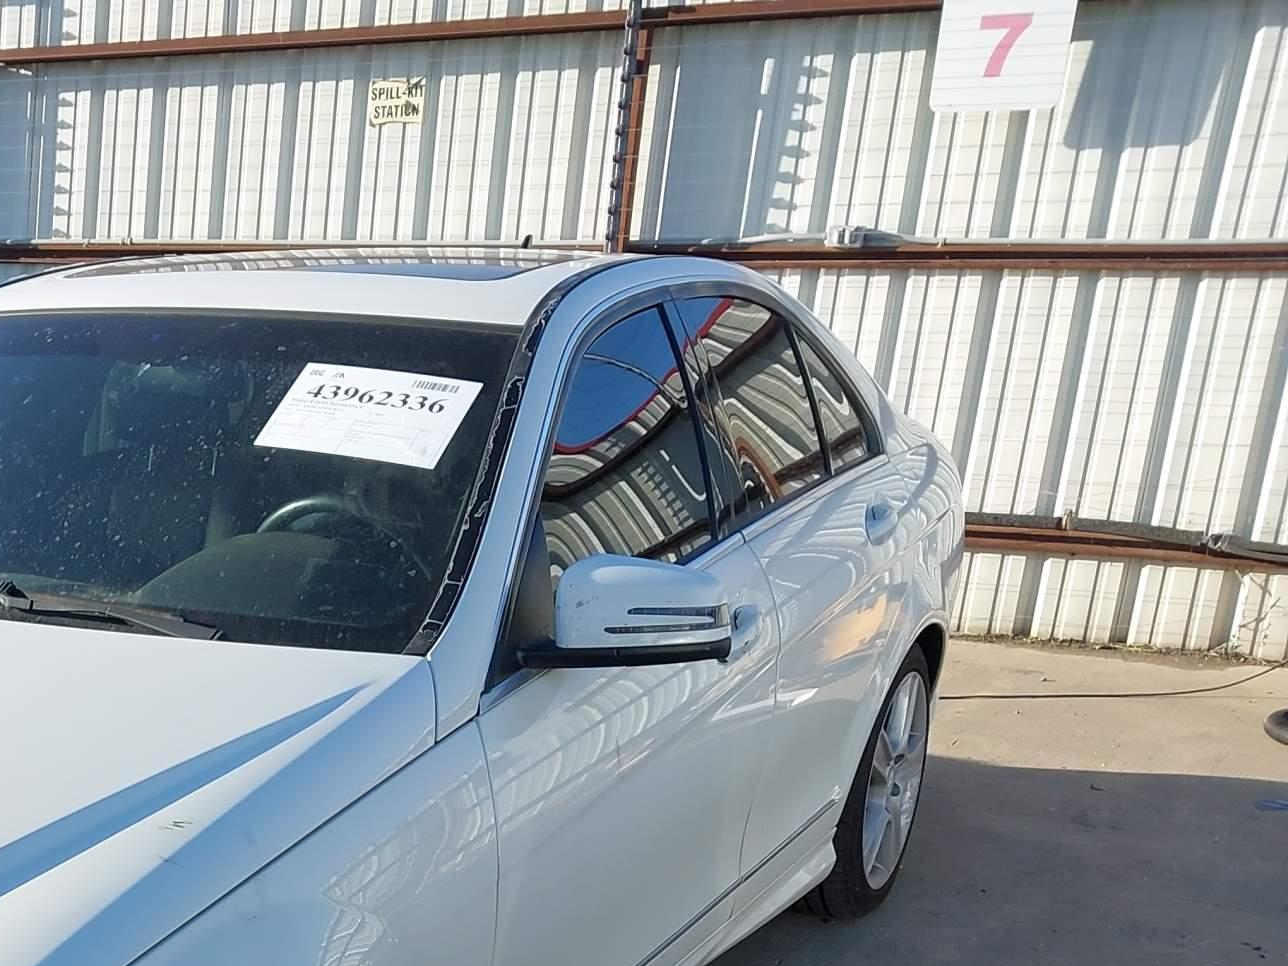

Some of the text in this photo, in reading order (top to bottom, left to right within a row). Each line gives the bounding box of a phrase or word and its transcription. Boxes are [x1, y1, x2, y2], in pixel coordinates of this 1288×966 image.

[979, 12, 1033, 77] 7
[371, 85, 425, 101] SPILL-KIT
[374, 104, 419, 119] STATION
[307, 384, 446, 414] 43962336
